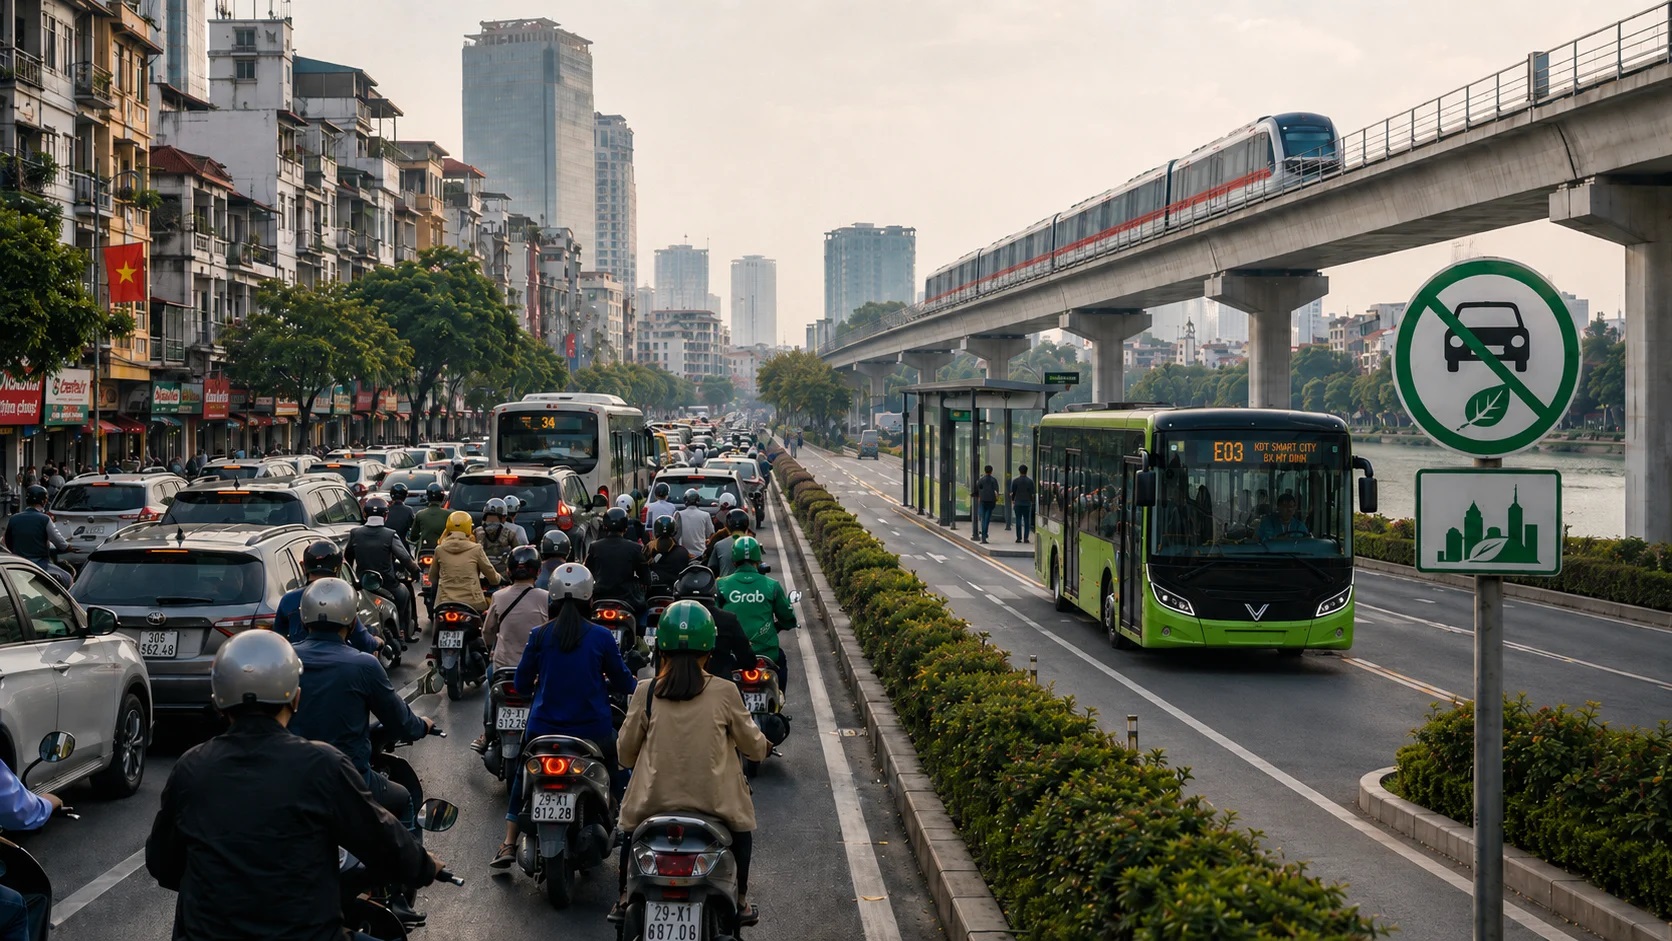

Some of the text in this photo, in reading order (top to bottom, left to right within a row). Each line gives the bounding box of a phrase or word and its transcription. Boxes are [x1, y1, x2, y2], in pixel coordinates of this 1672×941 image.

[541, 416, 556, 429] 34
[1214, 442, 1244, 462] E03
[1272, 442, 1297, 452] SMART
[1300, 443, 1316, 452] CITY
[729, 589, 765, 603] Grab
[539, 794, 568, 806] 29-X1
[534, 807, 571, 820] 912.28
[654, 905, 691, 922] 29-X1
